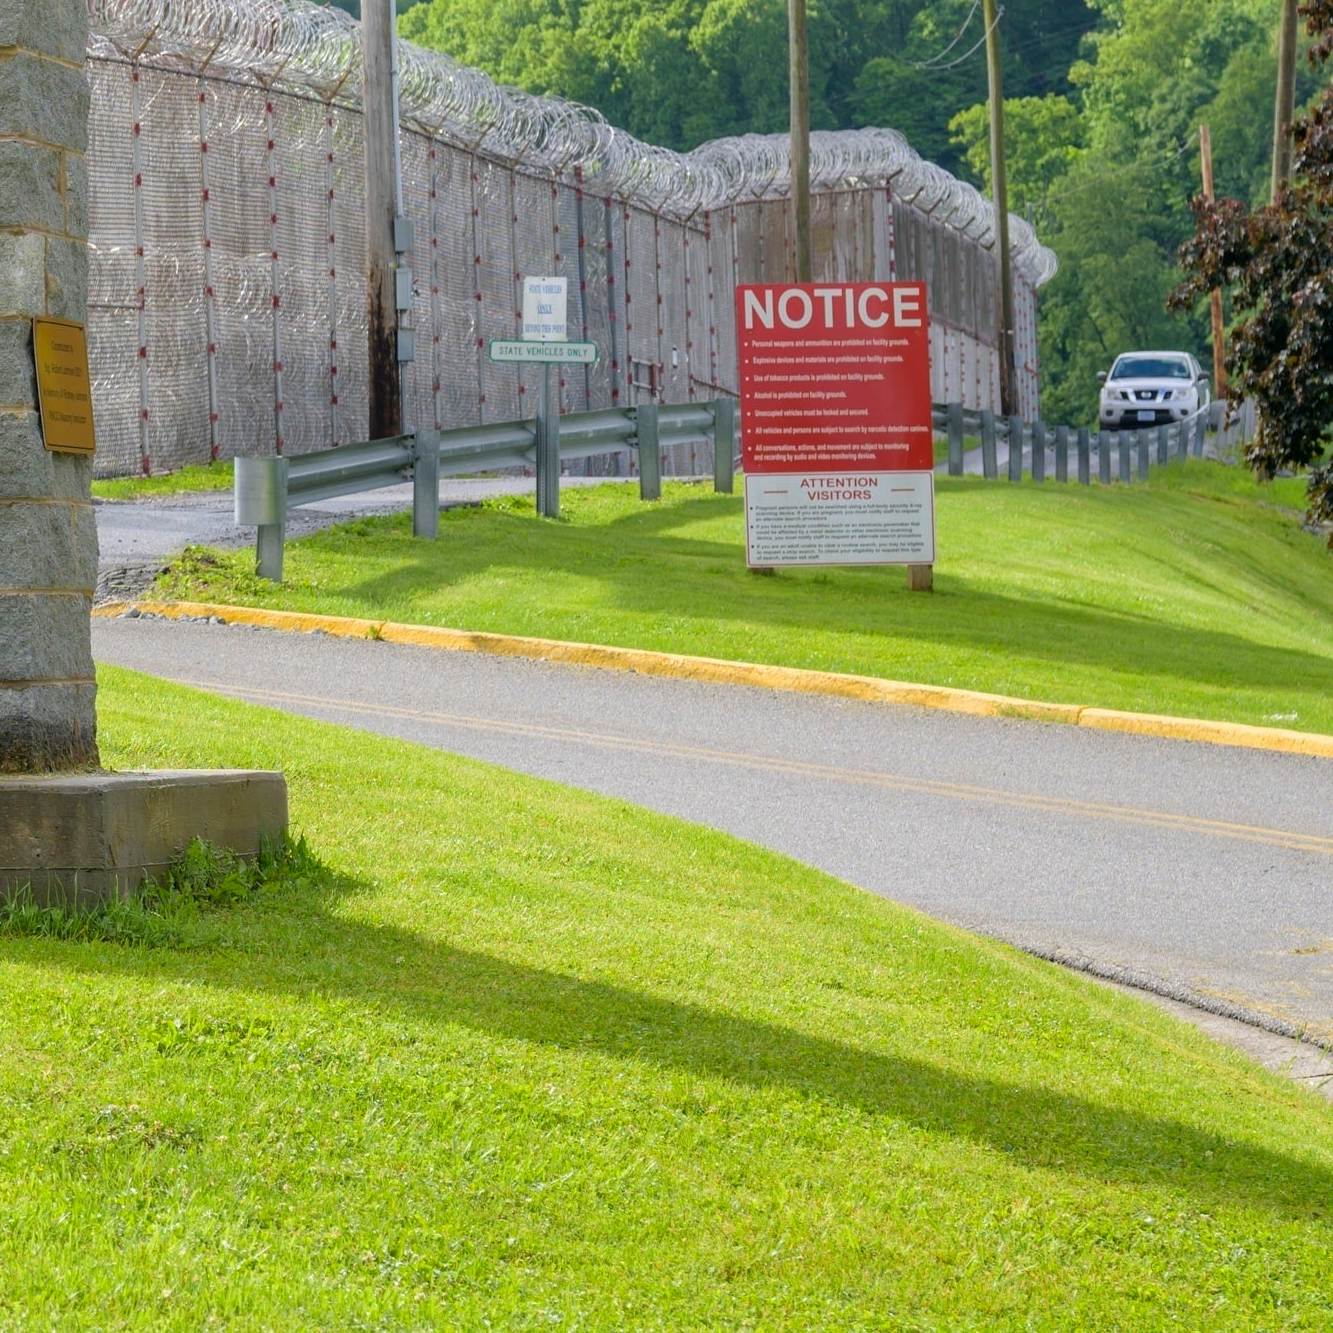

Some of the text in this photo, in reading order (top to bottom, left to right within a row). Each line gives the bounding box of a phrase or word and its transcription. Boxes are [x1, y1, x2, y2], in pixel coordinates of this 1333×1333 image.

[743, 287, 922, 329] NOTICE
[499, 346, 589, 357] STATE VEHICLES ONLY
[800, 477, 878, 489] ATTENTION
[807, 490, 872, 501] VISITORS
